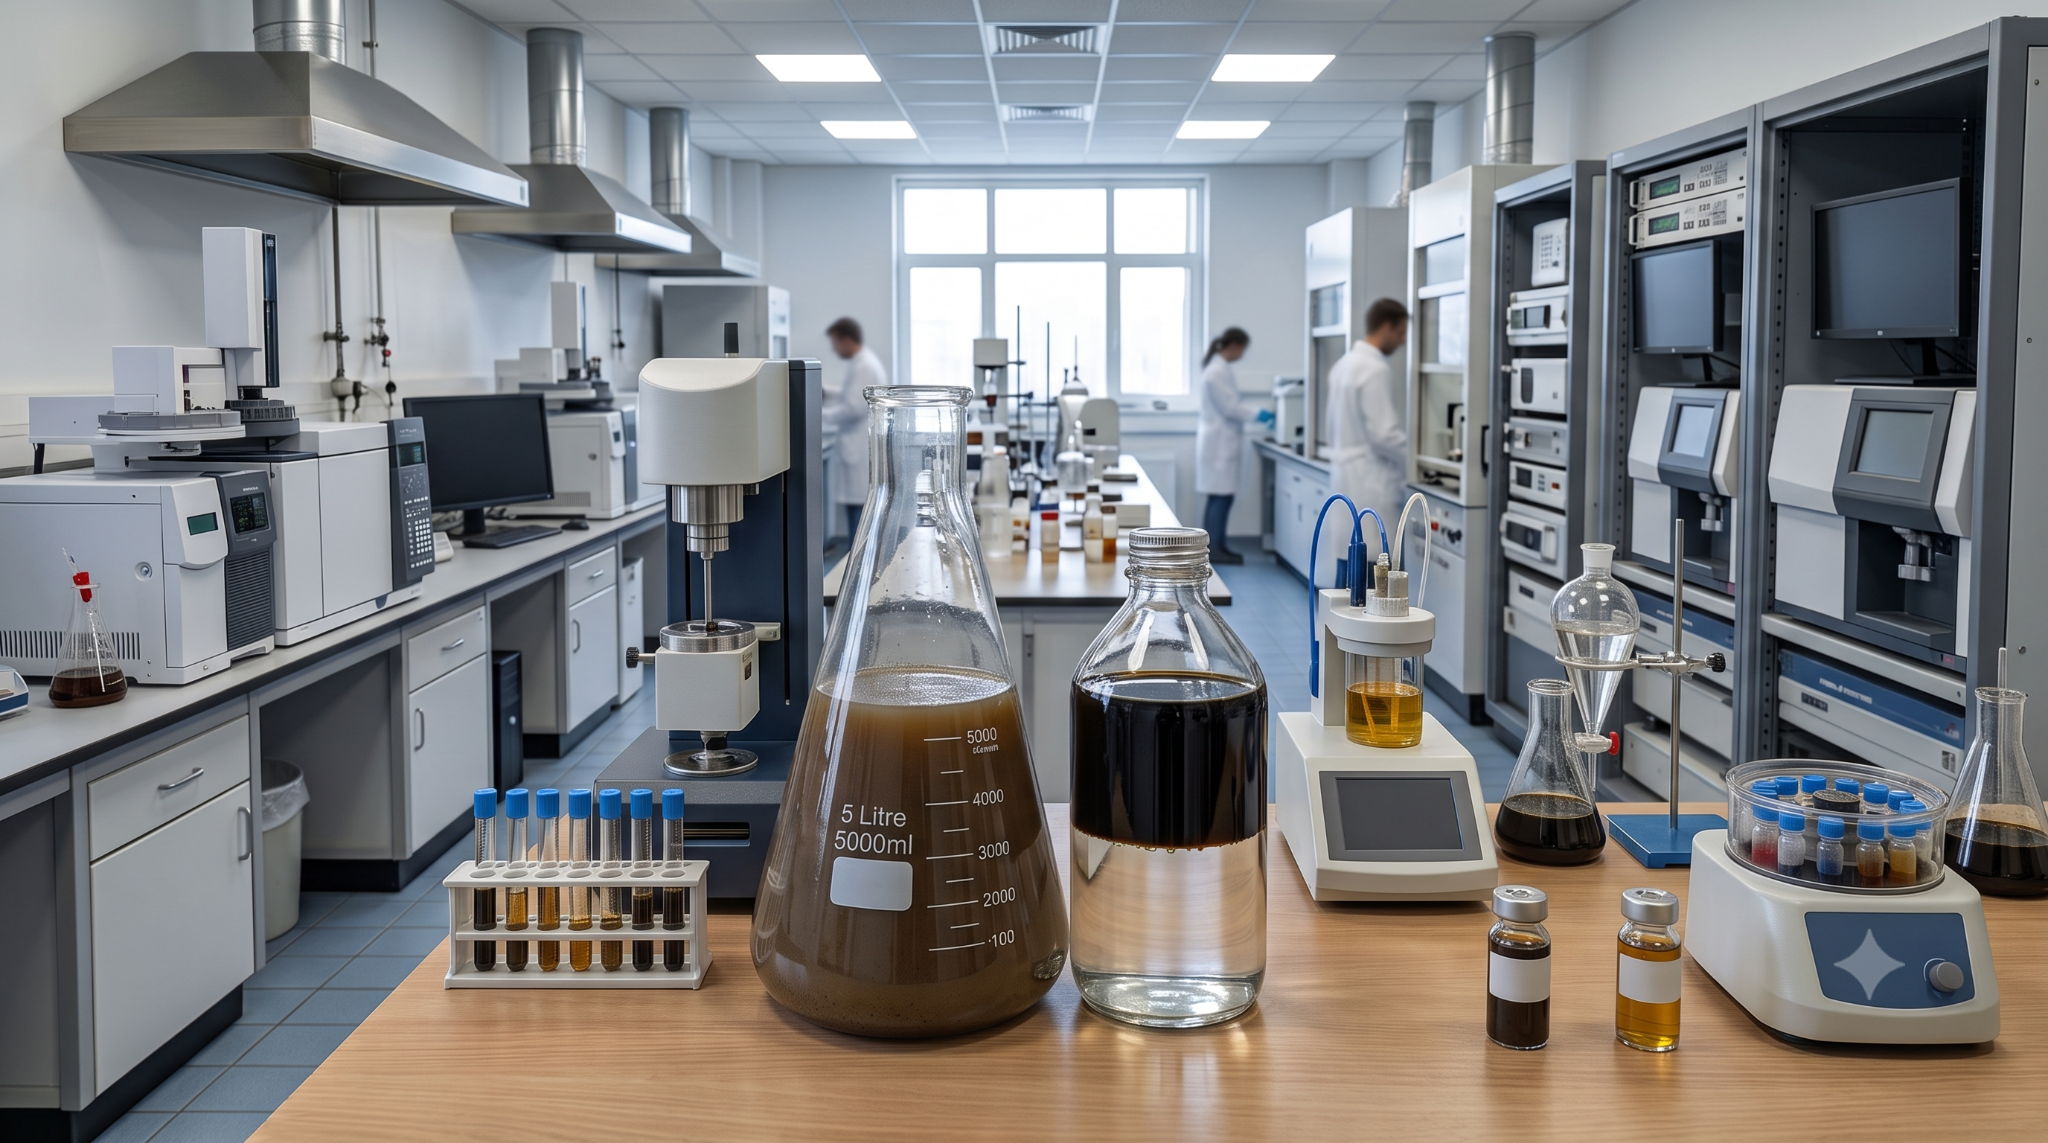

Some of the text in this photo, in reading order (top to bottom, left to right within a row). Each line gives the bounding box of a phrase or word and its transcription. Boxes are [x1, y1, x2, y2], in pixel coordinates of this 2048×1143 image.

[967, 727, 997, 744] 5000
[972, 789, 1004, 807] 4000
[841, 804, 907, 828] 5 Litre
[834, 830, 913, 855] 5000ml
[978, 840, 1010, 860] 3000
[983, 887, 1016, 908] 2000
